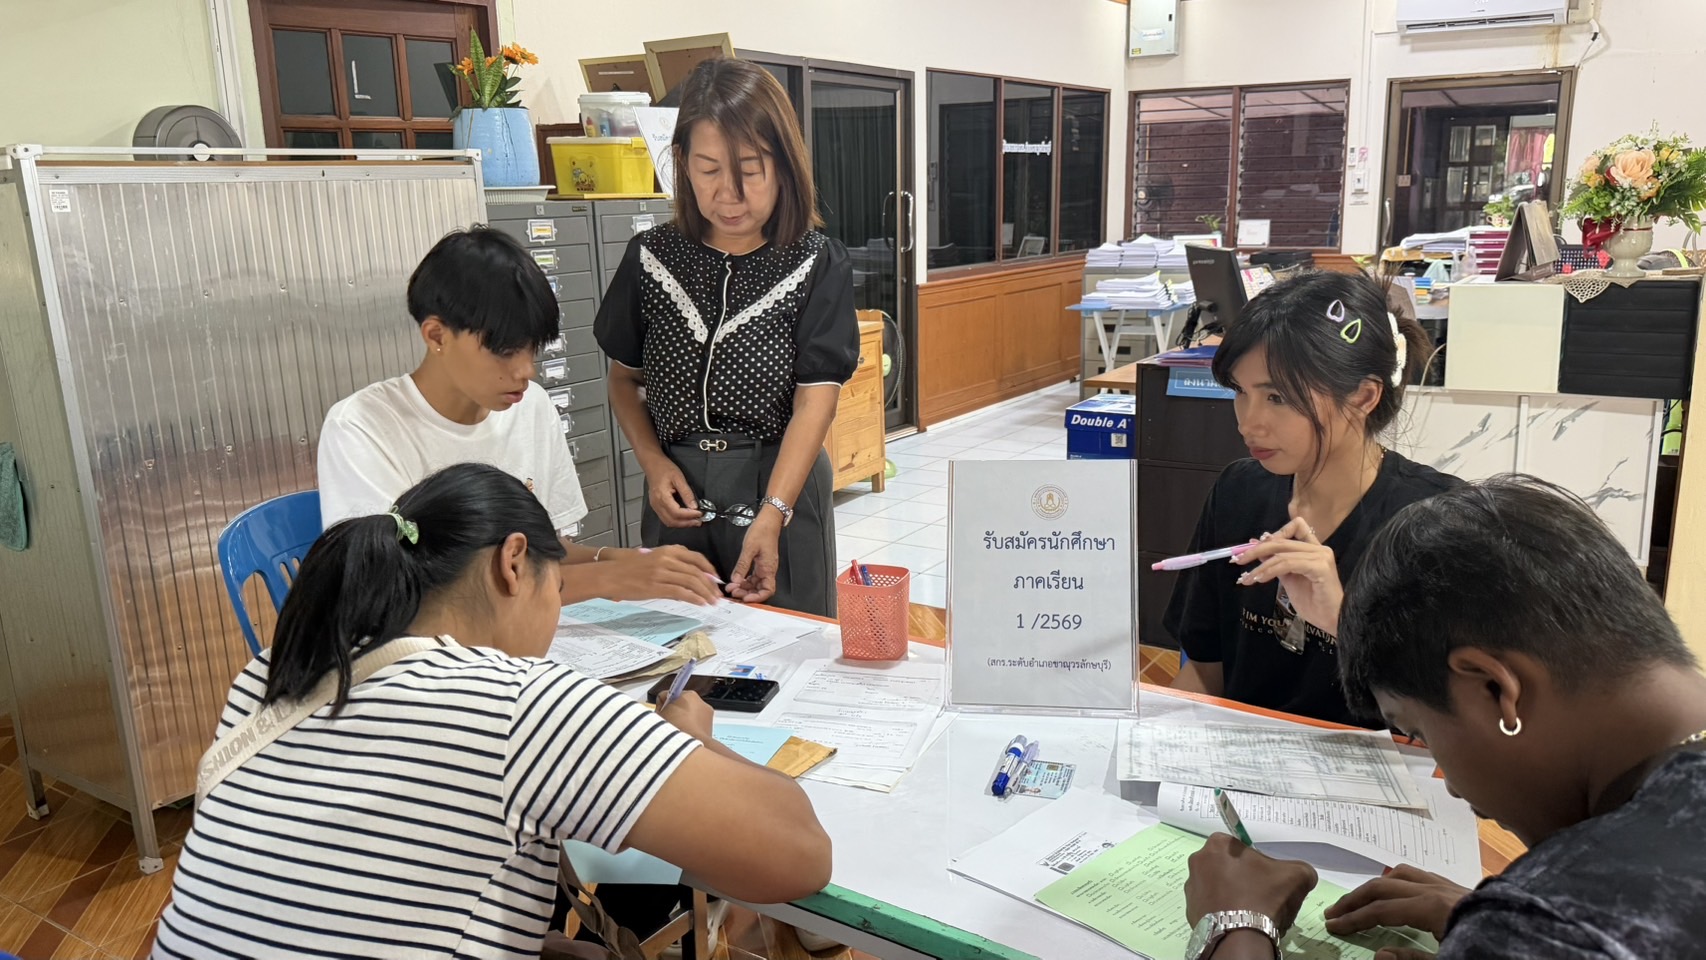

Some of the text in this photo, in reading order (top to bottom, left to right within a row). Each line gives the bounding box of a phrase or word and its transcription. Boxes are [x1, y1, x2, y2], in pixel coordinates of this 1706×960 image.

[1071, 414, 1127, 429] Double A
[983, 530, 1115, 551] รับสมัครนักศึกษา
[1013, 569, 1084, 590] ภาคเรียน
[1016, 612, 1082, 629] 1 /2569
[987, 656, 1112, 673] (สกร.ระดับอำเภอขาณุวรลักษบุรี)
